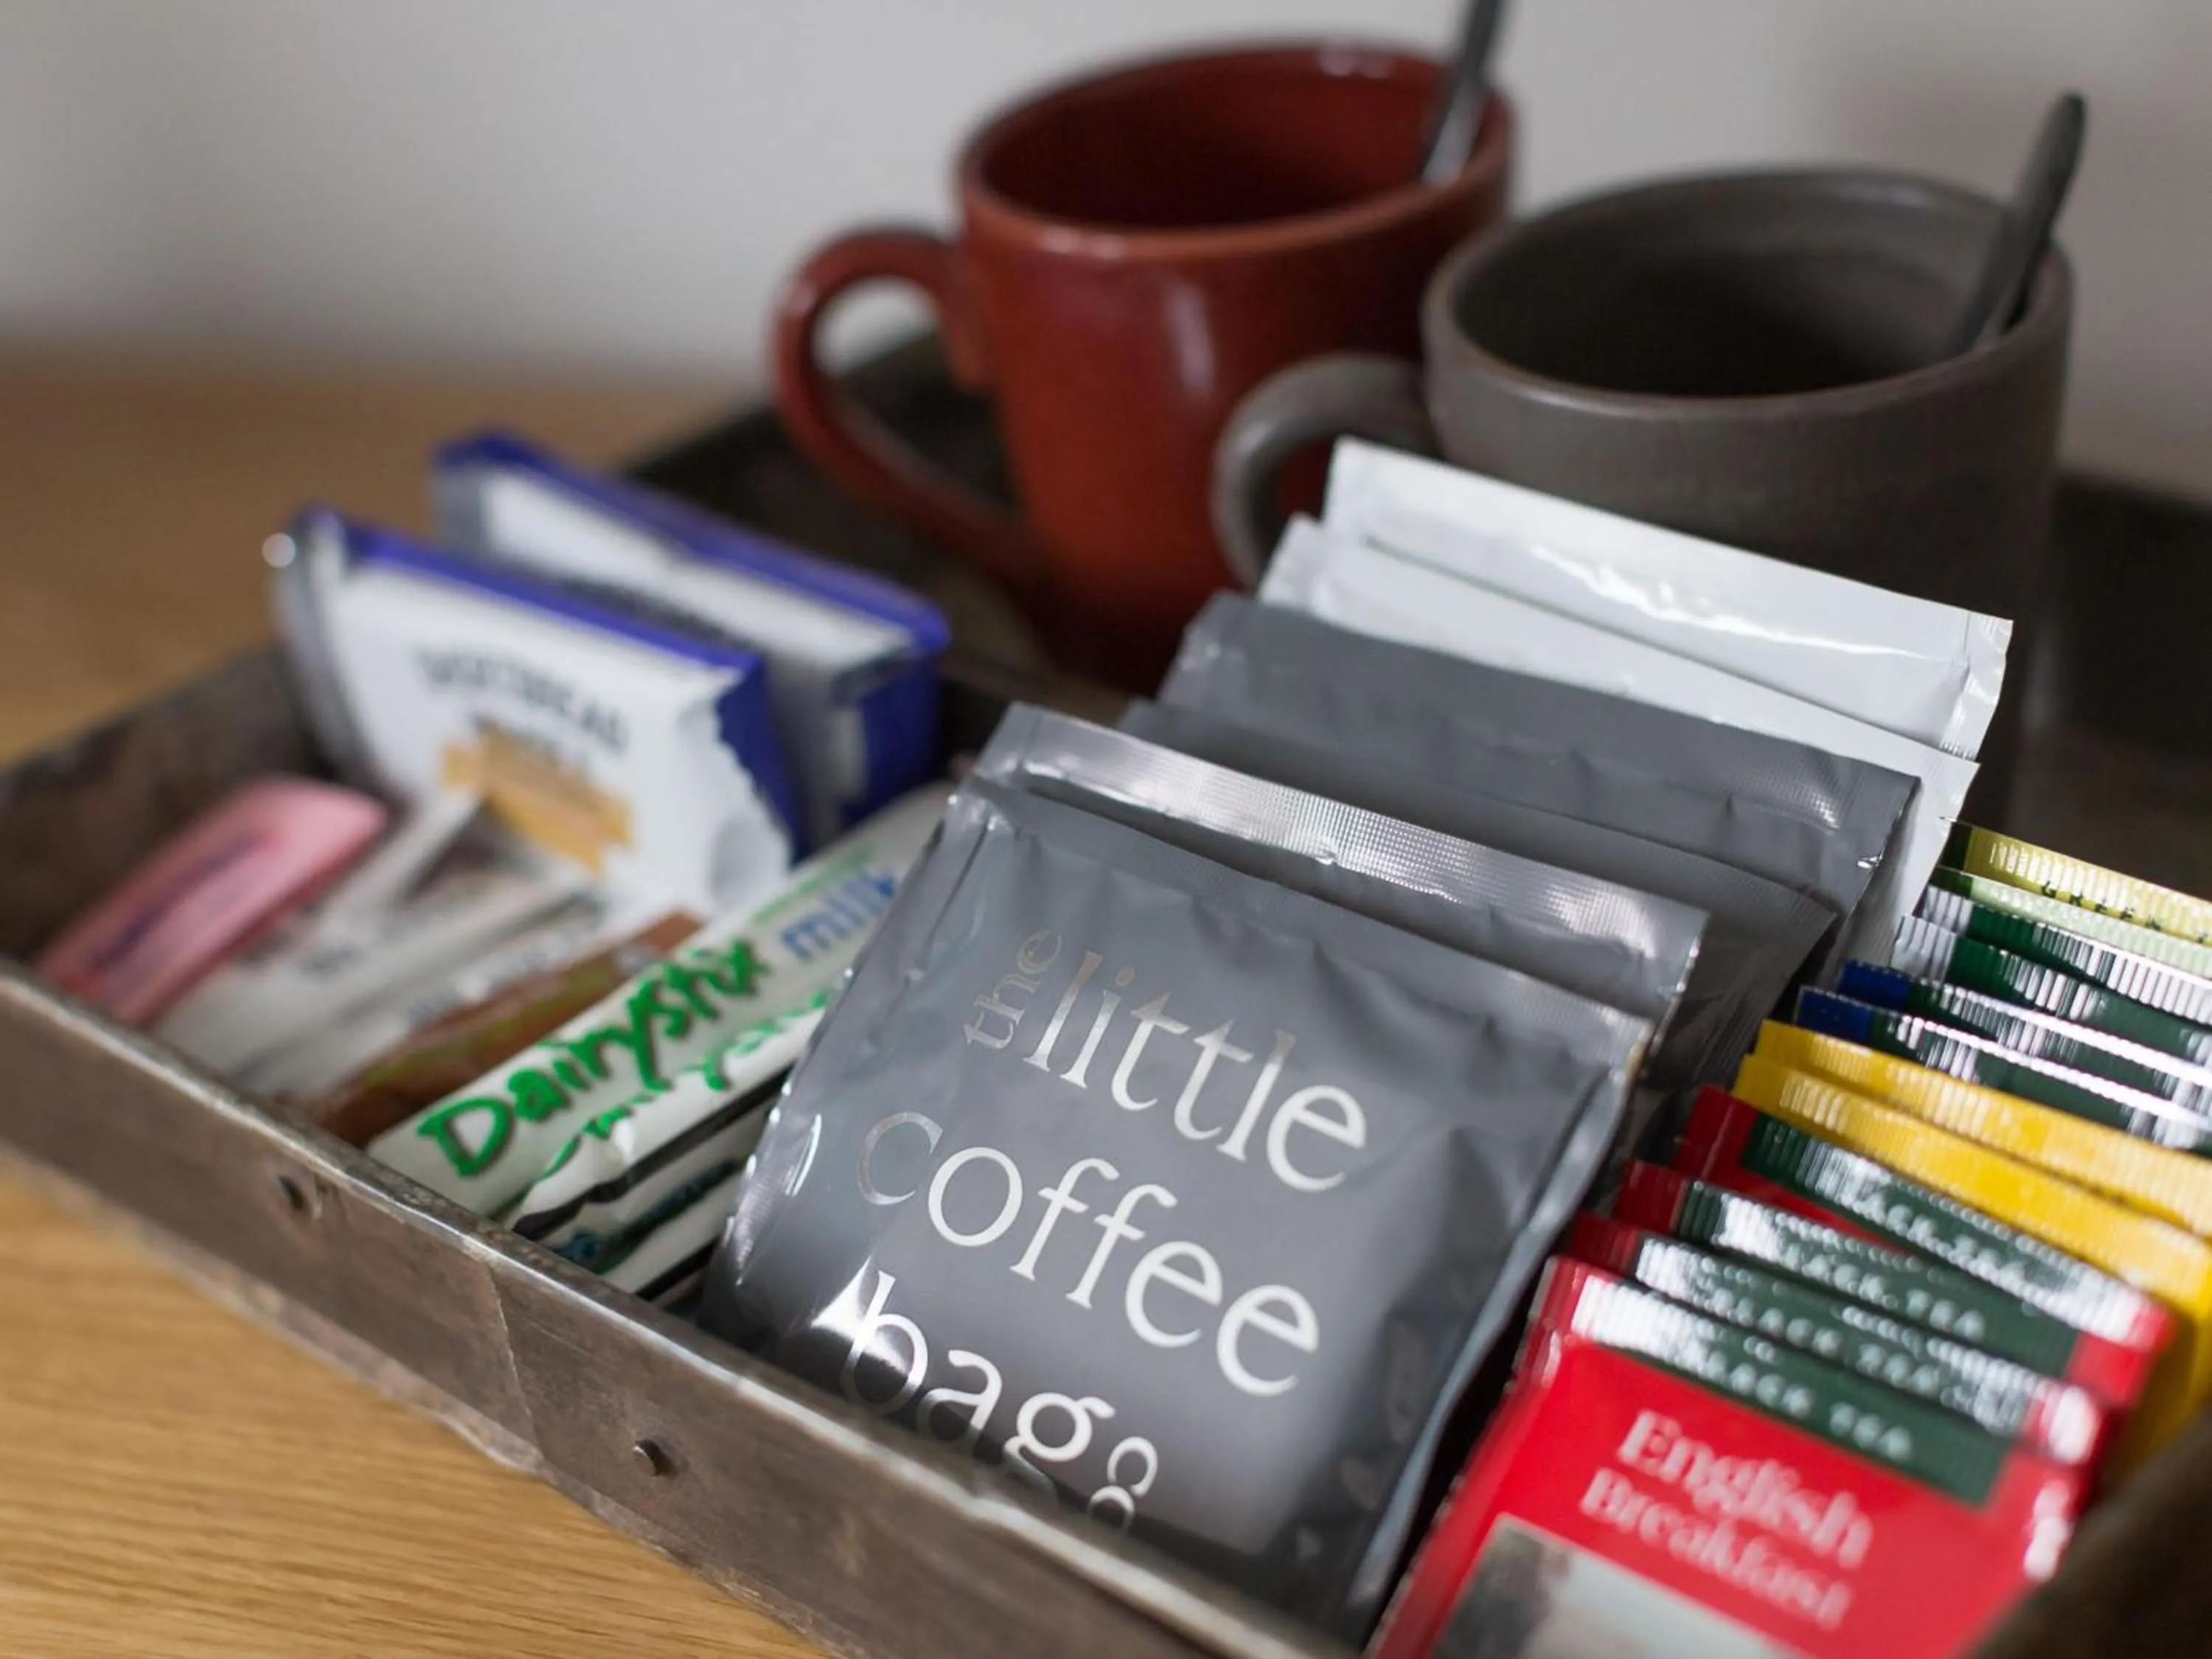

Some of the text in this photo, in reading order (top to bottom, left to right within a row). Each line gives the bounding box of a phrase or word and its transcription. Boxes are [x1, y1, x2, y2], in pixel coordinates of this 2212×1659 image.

[961, 929, 1063, 1050] the
[1023, 950, 1367, 1192] little
[858, 1110, 1321, 1397] coffee
[1906, 1286, 1988, 1345] TEA
[1618, 1407, 1874, 1571] English
[1830, 1401, 1914, 1463] TEA
[1579, 1466, 1855, 1632] Breakfast
